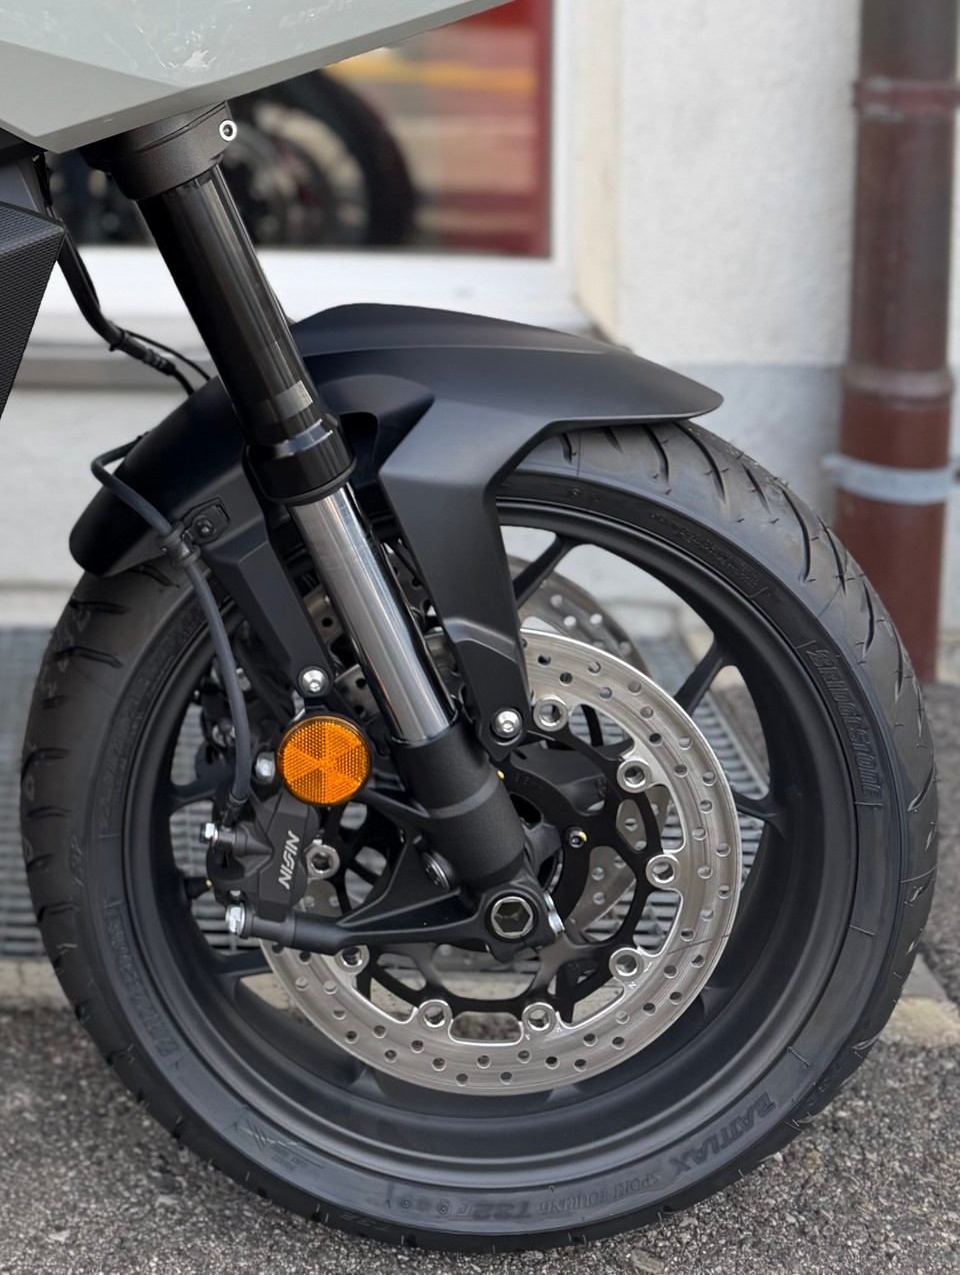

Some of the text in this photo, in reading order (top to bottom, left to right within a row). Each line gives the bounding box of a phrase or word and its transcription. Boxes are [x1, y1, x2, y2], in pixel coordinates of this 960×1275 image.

[669, 1091, 777, 1176] BATTLAX
[613, 1173, 660, 1199] SPORT
[540, 1189, 609, 1216] TOURING
